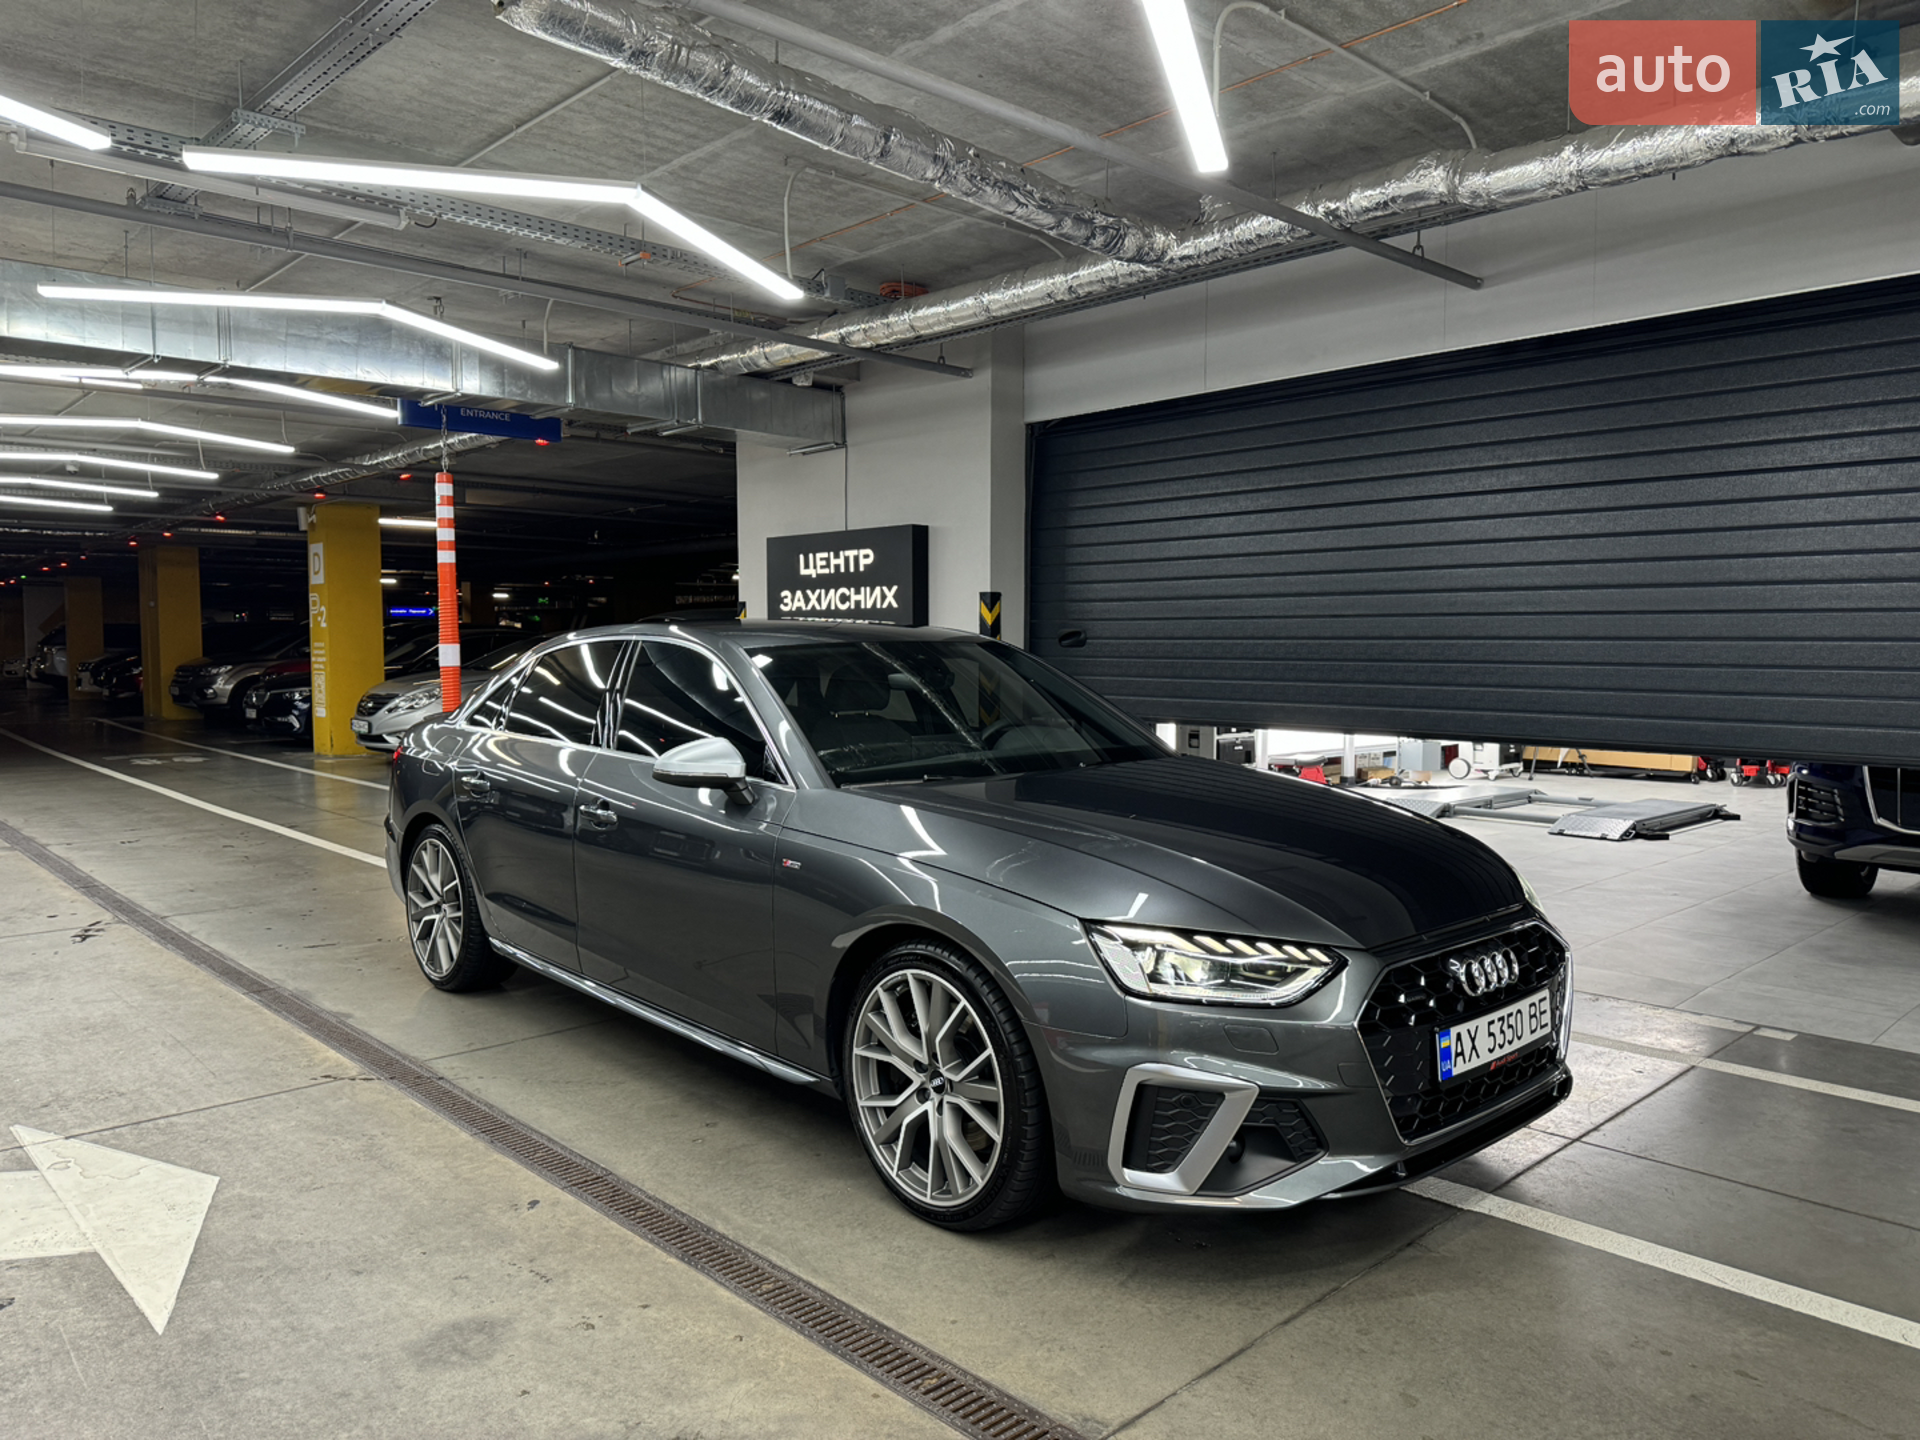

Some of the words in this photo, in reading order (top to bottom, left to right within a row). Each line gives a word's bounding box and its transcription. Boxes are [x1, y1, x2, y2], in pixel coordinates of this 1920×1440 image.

[460, 407, 511, 422] ENTRANCE
[312, 552, 322, 577] D
[799, 548, 875, 578] ЦЕНТР
[779, 585, 899, 612] ЗАХИСНИХ
[1454, 1025, 1480, 1068] AX
[1487, 1008, 1524, 1054] 5350
[1529, 997, 1549, 1035] BE
[1441, 1059, 1452, 1072] UA
